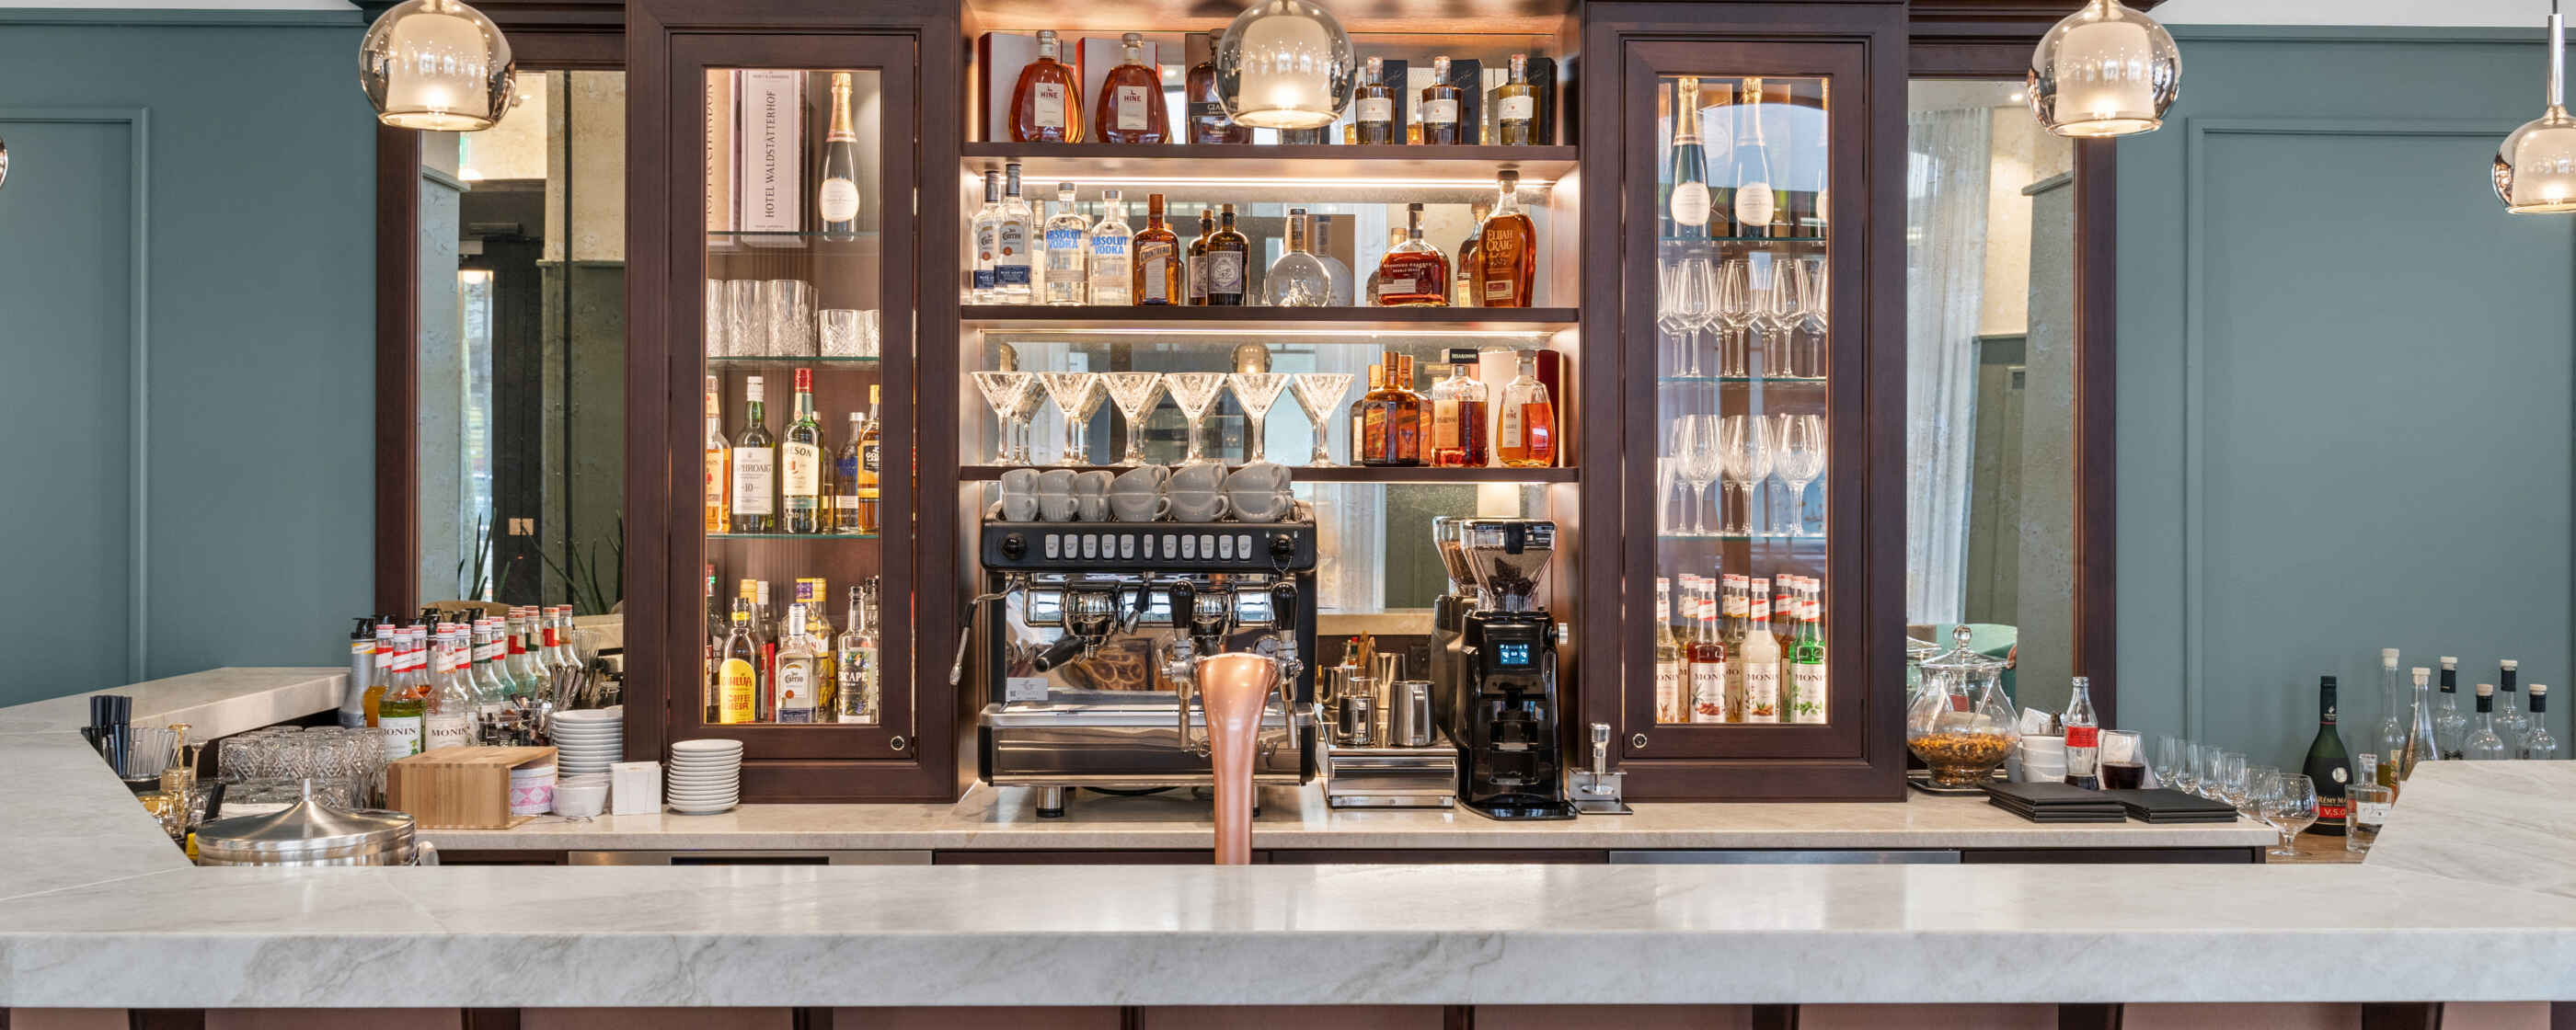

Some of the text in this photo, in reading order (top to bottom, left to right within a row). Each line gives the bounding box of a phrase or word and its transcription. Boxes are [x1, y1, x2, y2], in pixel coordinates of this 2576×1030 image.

[765, 187, 775, 218] HOTEL
[1046, 229, 1083, 239] ABSOLUT
[1486, 229, 1513, 241] ELIJAH
[1092, 236, 1128, 245] ABSOLUT
[1486, 239, 1512, 252] CRAIG
[1096, 245, 1124, 255] VODKA
[744, 483, 753, 493] 10
